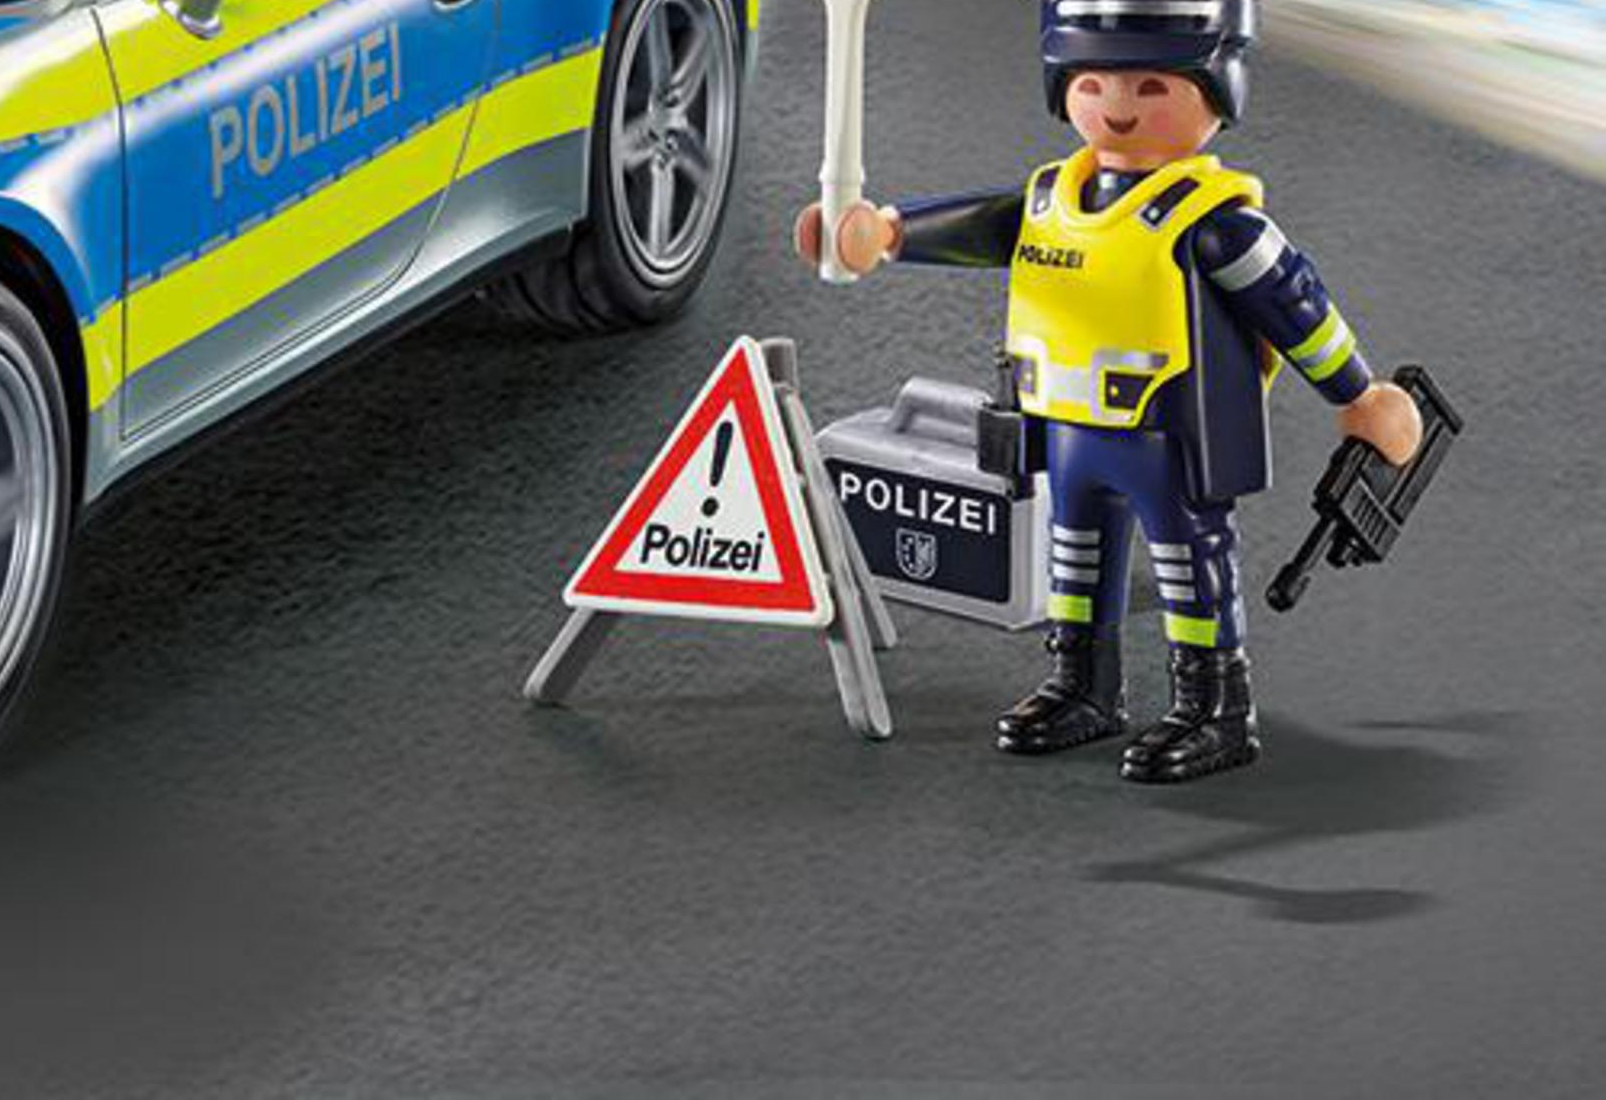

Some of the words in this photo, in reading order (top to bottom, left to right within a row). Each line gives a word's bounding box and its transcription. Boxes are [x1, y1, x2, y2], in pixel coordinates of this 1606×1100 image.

[208, 21, 400, 199] POLIZEI
[1018, 244, 1084, 269] POLIZEI
[839, 472, 996, 534] POLIZEI
[640, 524, 765, 572] Polizei
